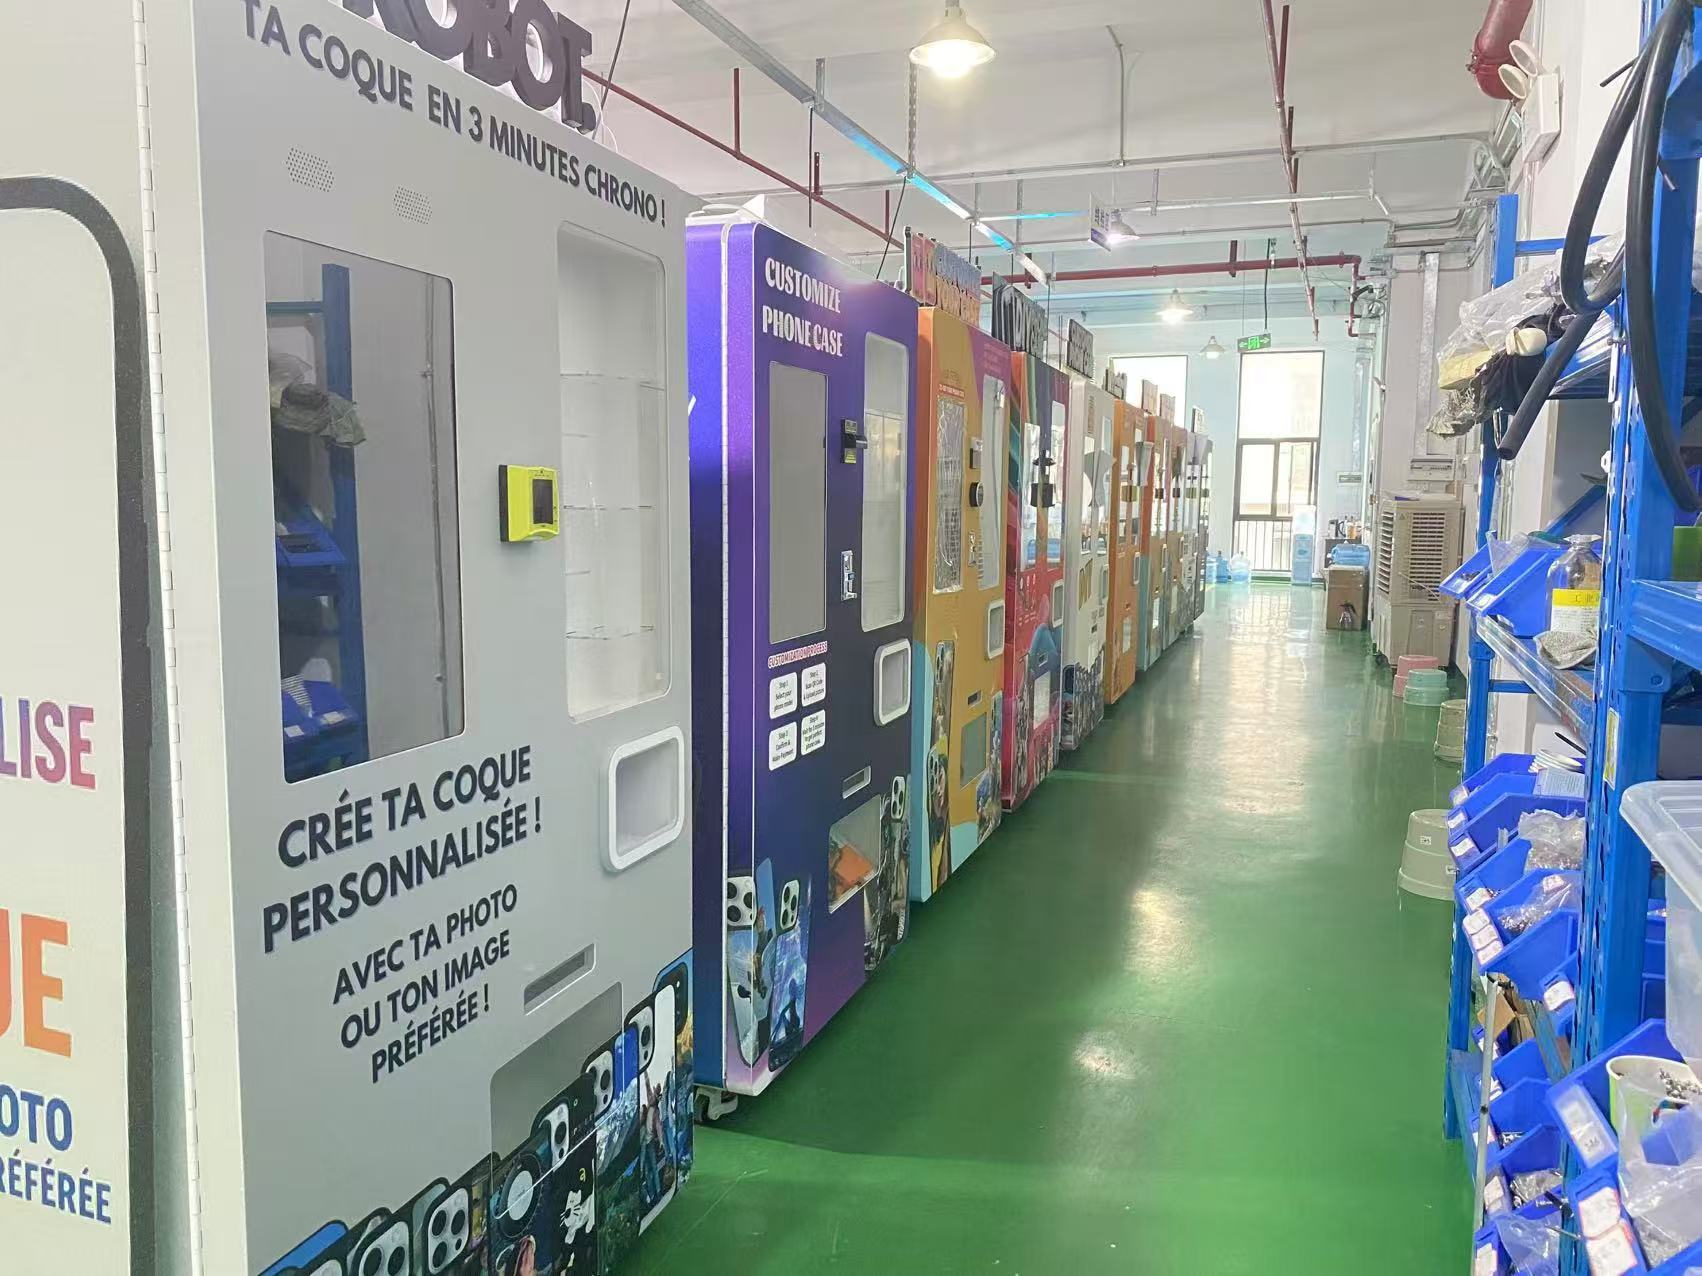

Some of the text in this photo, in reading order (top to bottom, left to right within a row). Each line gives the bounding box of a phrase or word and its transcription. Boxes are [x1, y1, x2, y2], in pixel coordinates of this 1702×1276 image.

[238, 0, 291, 56] TA
[298, 23, 414, 112] COQUE
[427, 84, 462, 134] EN
[468, 105, 484, 142] 3
[489, 115, 580, 187] MINUTES
[584, 164, 658, 223] CHRONO
[762, 305, 843, 357] PHONE CASE
[765, 257, 840, 313] CUSTOMIZE
[0, 697, 96, 790] LISE
[278, 745, 531, 868] CRÉE TA COQUE
[263, 797, 527, 954] PERSONNALISÉE
[0, 909, 71, 1058] E
[333, 884, 517, 1004] AVEC TA PHOTO
[341, 929, 510, 1048] OU TON IMAGE
[372, 989, 478, 1084] PRÉFÉRÉE
[0, 1084, 73, 1151] OTO
